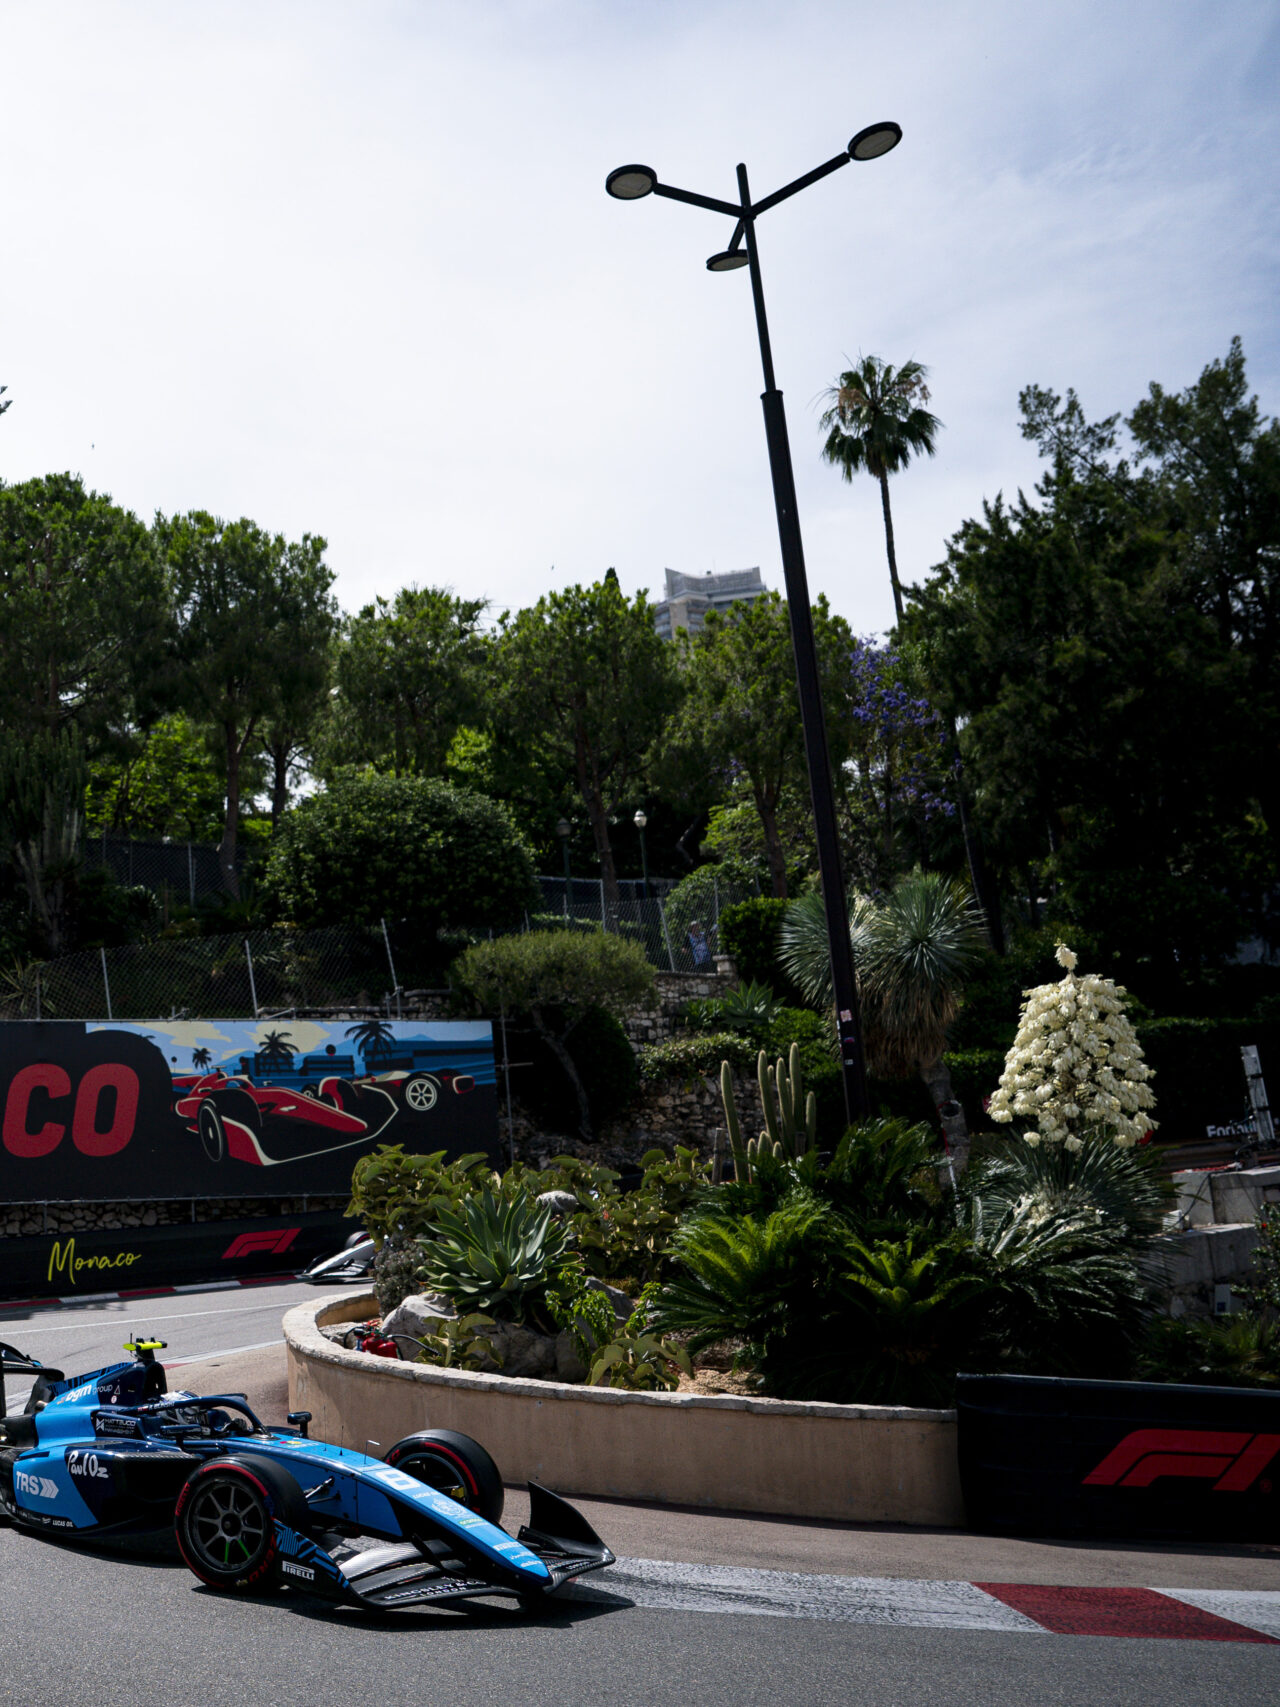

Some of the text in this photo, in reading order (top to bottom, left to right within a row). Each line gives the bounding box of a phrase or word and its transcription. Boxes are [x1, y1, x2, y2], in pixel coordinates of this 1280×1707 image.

[48, 1238, 142, 1285] Monaco
[16, 1471, 39, 1495] TRS
[375, 1469, 421, 1491] 8
[282, 1560, 314, 1581] PIRELLI
